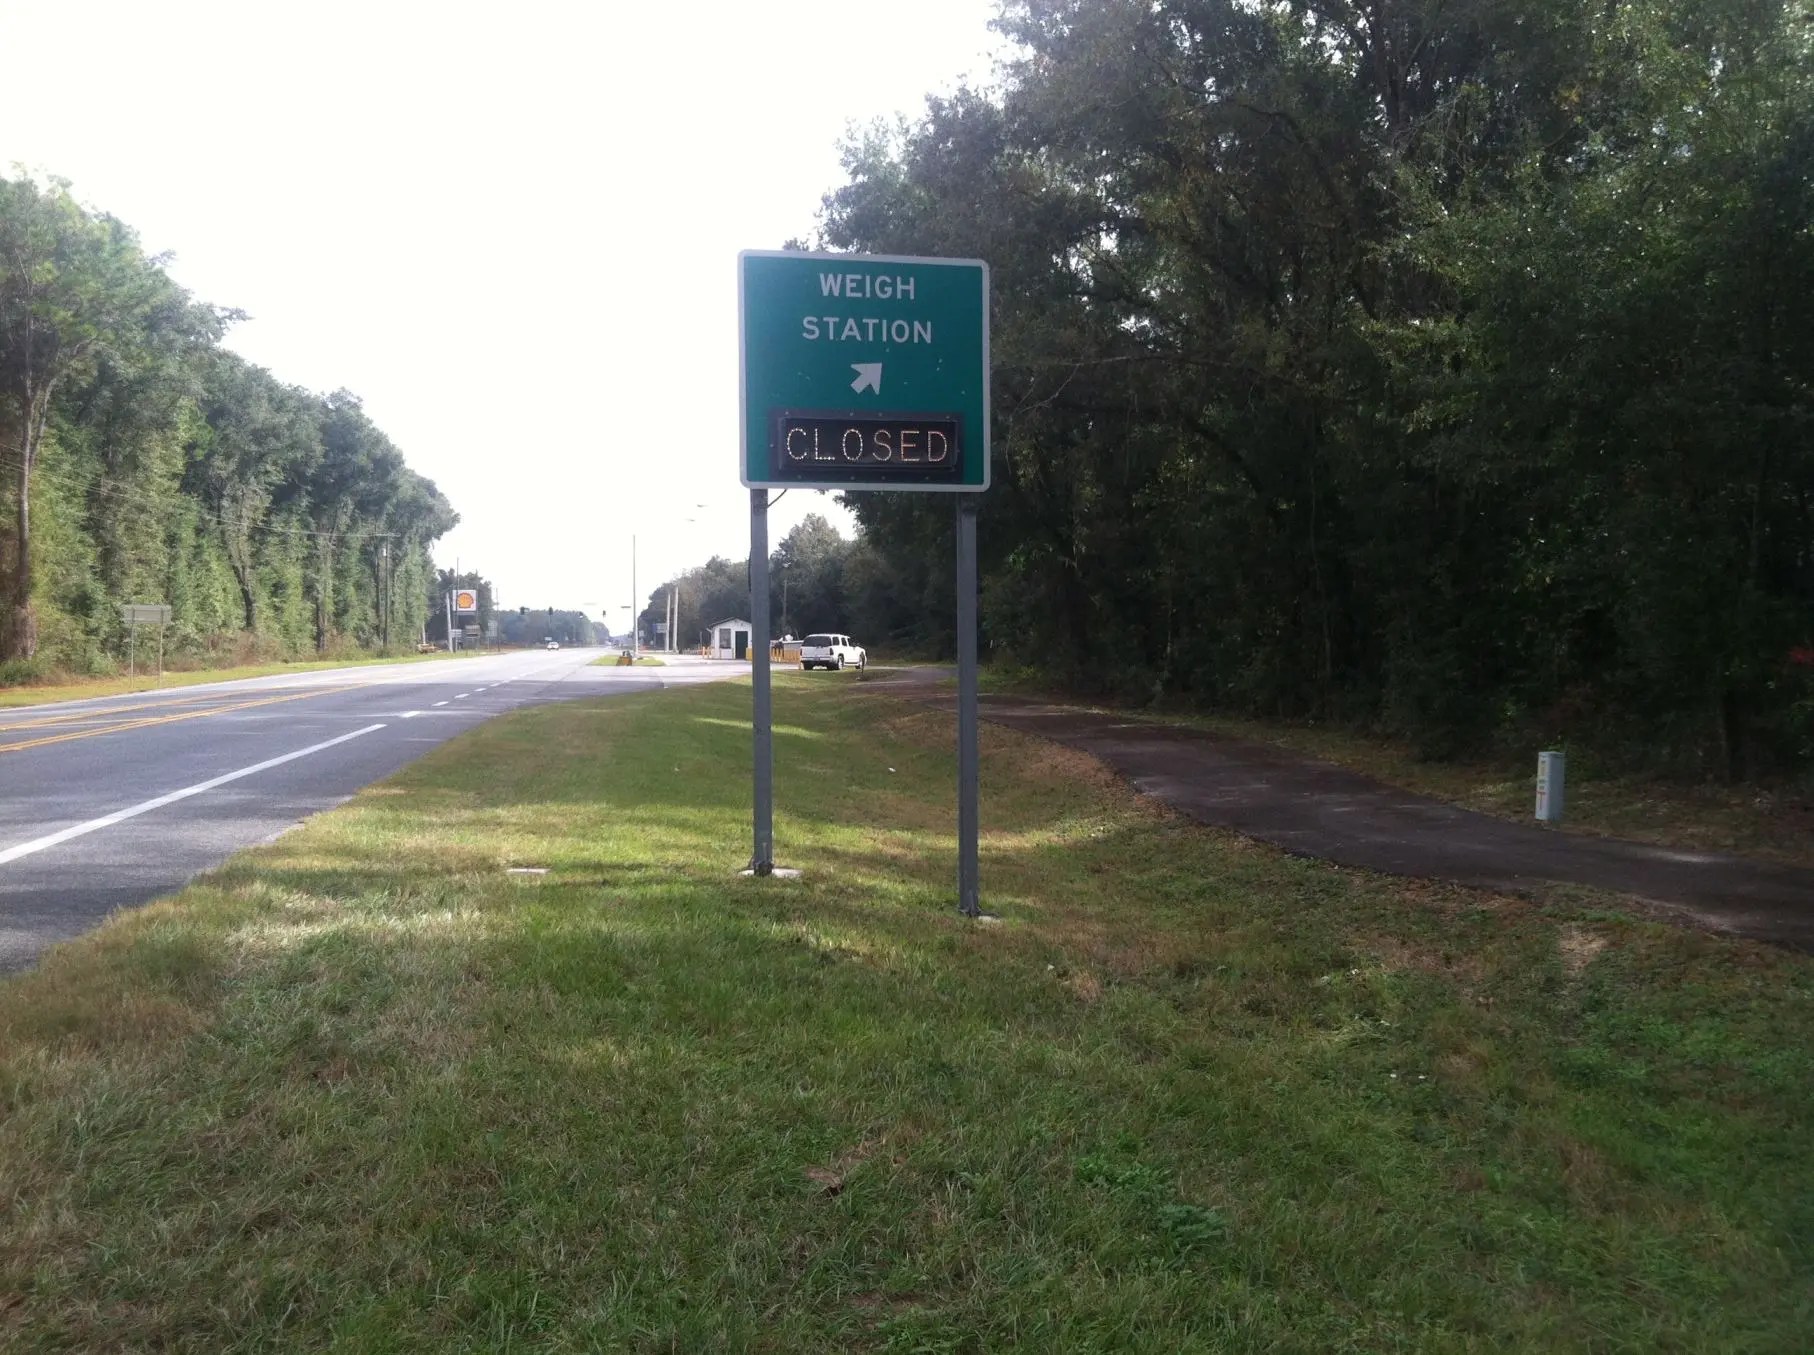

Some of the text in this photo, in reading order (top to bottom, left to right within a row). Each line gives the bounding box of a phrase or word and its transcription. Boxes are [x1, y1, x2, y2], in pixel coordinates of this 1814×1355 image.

[819, 273, 915, 300] WEIGH
[802, 316, 932, 344] STATION
[786, 428, 948, 462] CLOSED
